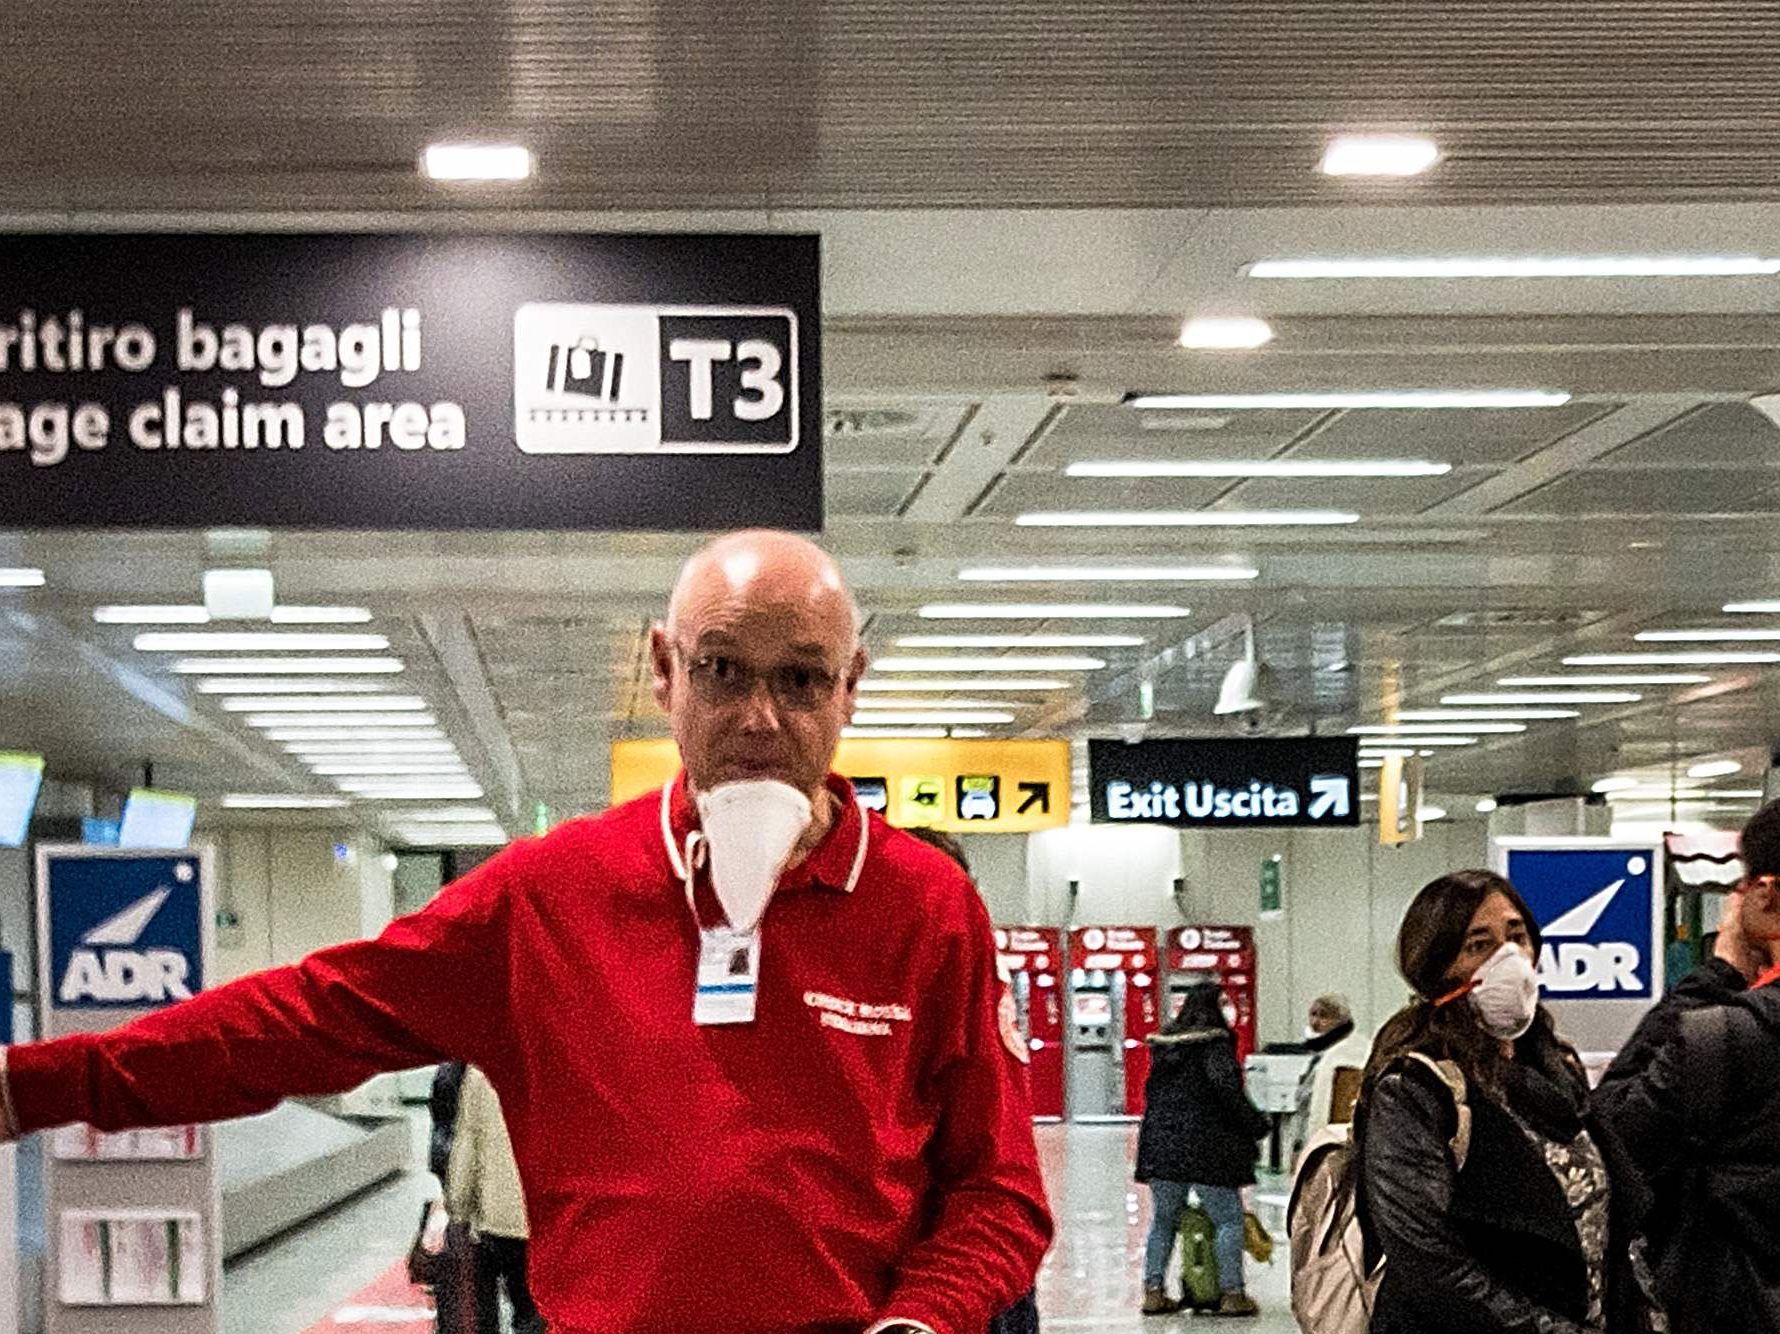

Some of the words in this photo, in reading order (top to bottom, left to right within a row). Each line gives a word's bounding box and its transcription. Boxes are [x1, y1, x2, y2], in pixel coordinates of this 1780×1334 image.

[0, 308, 157, 372] ritiro
[176, 305, 422, 387] bagagli
[670, 339, 785, 421] T3
[0, 402, 110, 467] age
[129, 385, 306, 450] claim
[323, 401, 467, 450] area
[1106, 780, 1181, 818] Exit
[1184, 779, 1300, 818] Uscita
[60, 949, 194, 1001] ADR
[1537, 942, 1644, 991] ADR
